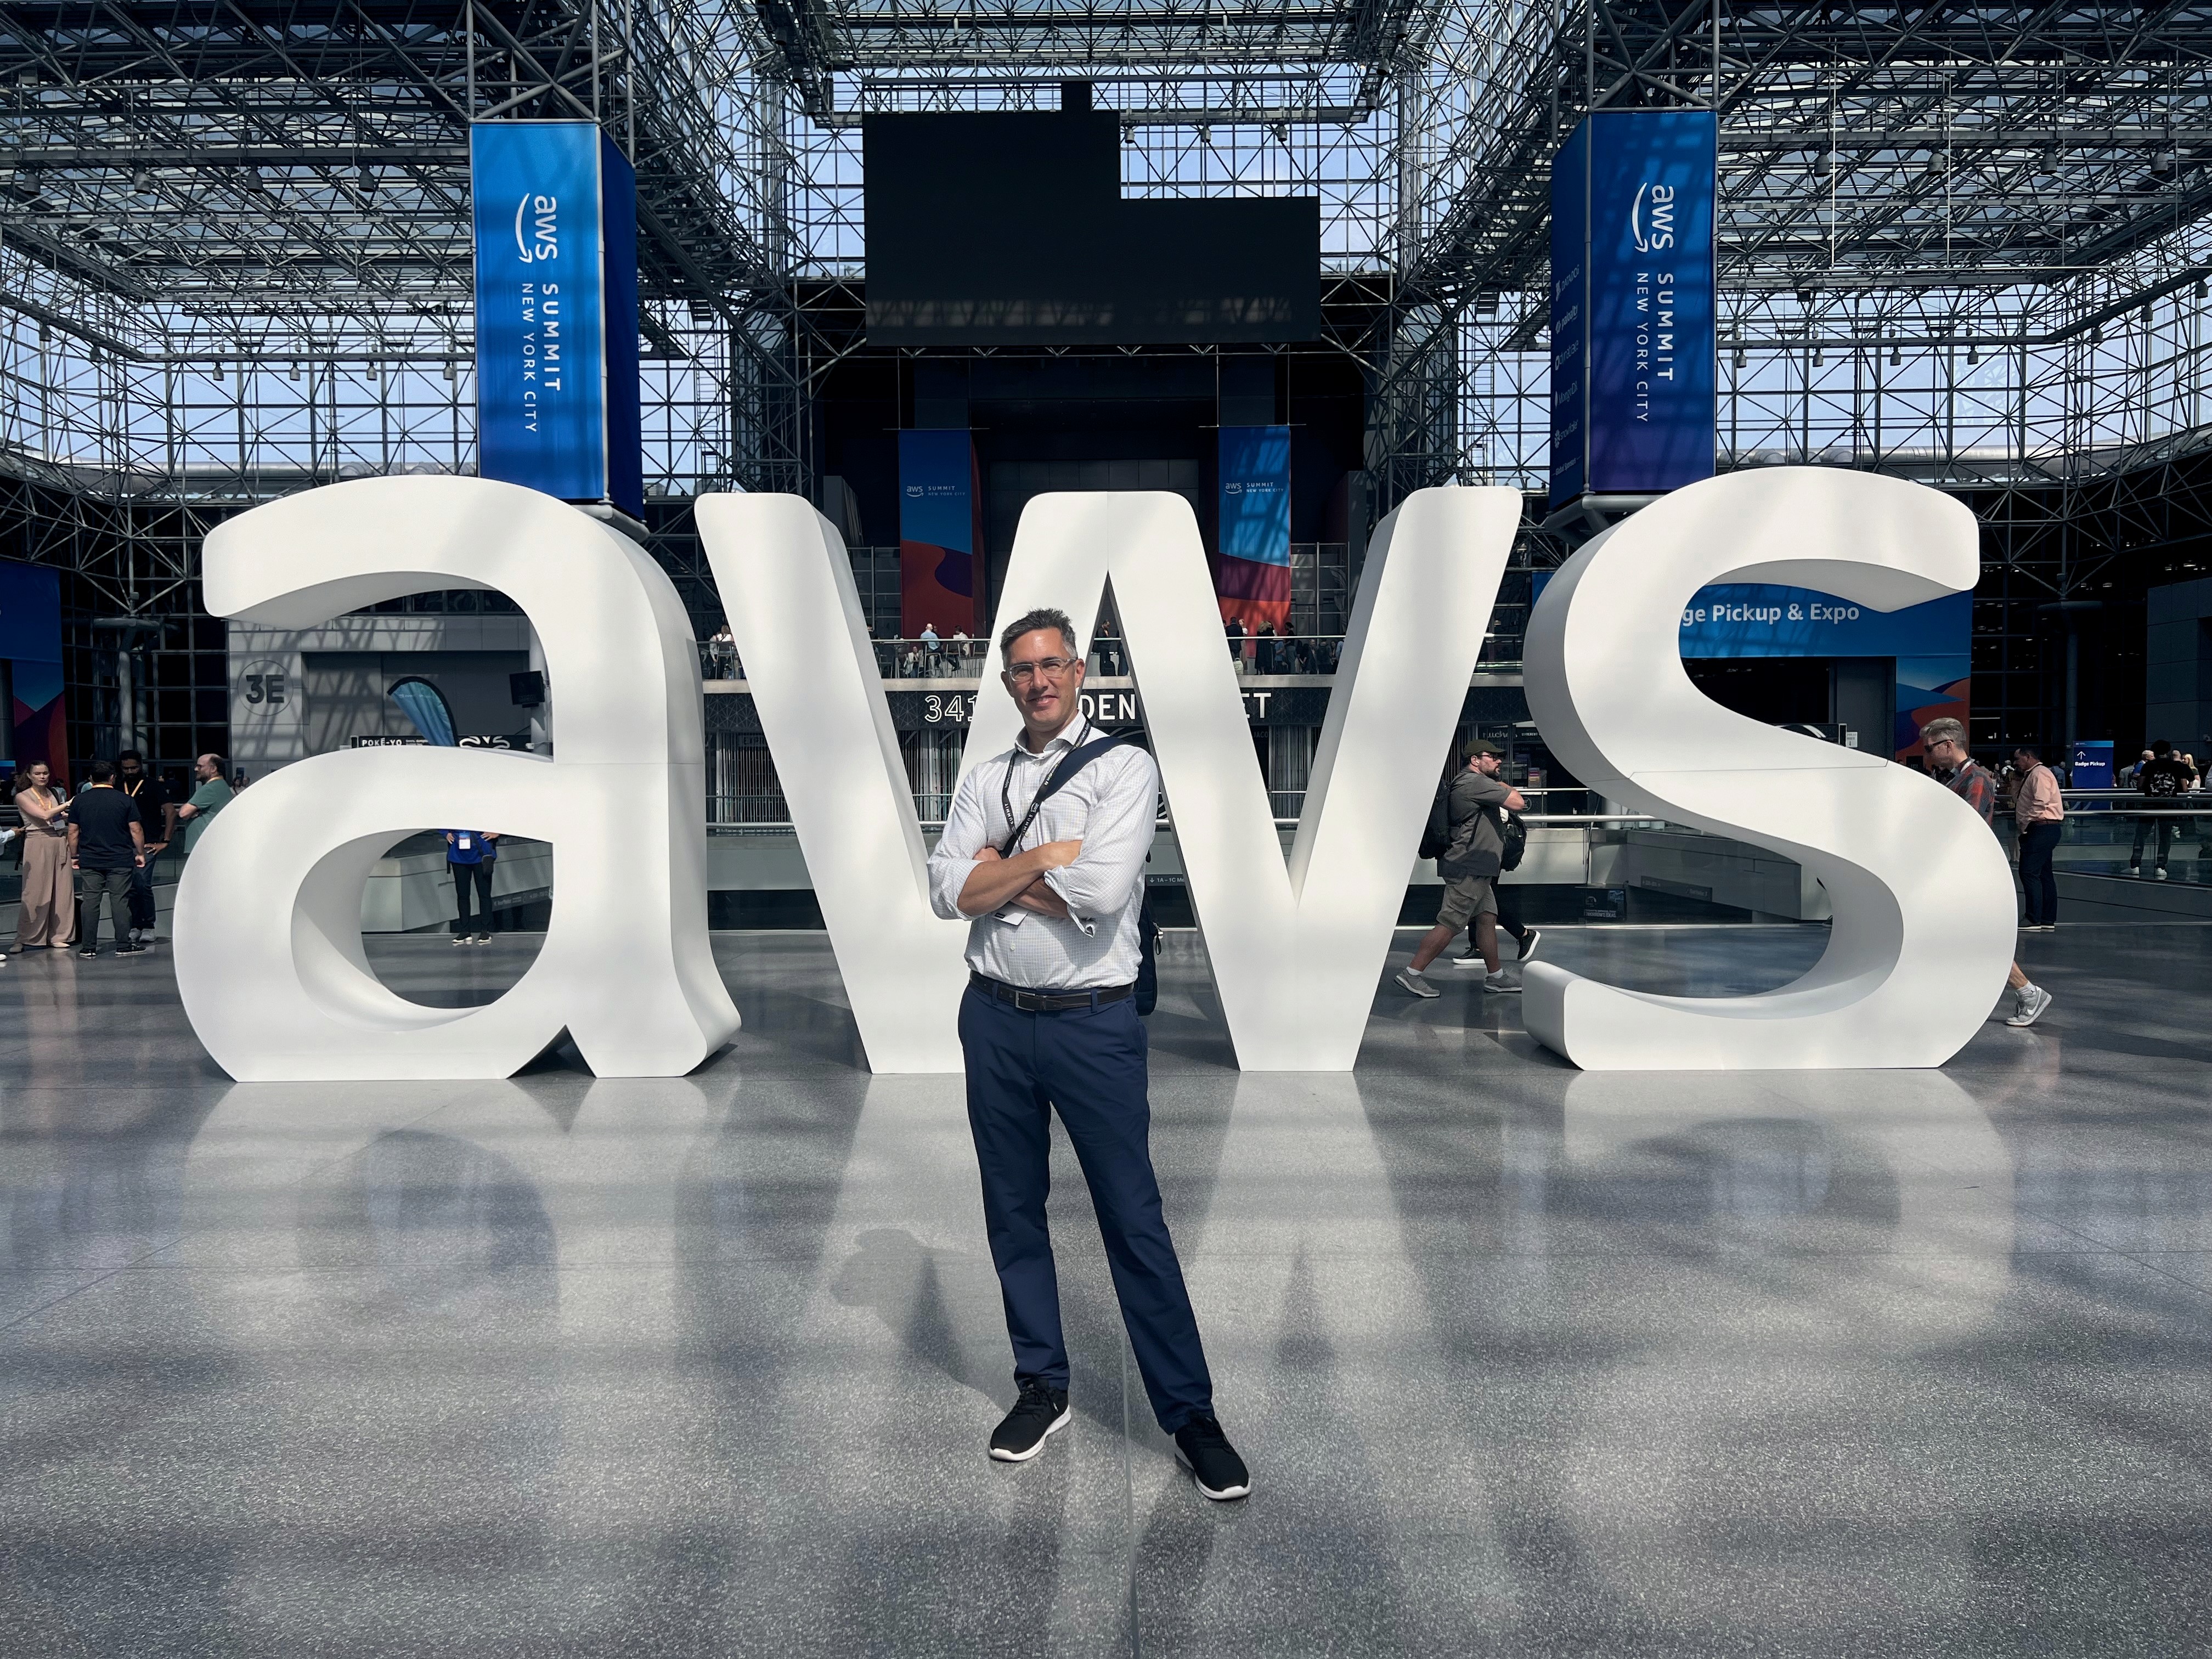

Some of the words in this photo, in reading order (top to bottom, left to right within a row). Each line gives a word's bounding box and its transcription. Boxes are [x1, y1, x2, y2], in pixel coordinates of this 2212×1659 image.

[534, 195, 557, 261] aws
[1651, 185, 1674, 250] aws
[522, 283, 534, 323] NEW
[1637, 273, 1649, 312] NEW
[543, 284, 561, 391] SUMMIT
[1637, 323, 1649, 370] YORK
[1657, 273, 1674, 381] SUMMIT
[523, 332, 535, 381] YORK
[524, 391, 537, 432] CITY
[1637, 381, 1649, 422] CITY
[1712, 603, 1781, 625] Pickup
[1787, 603, 1804, 621] &
[1810, 603, 1859, 625] Expo
[246, 674, 285, 704] 3E
